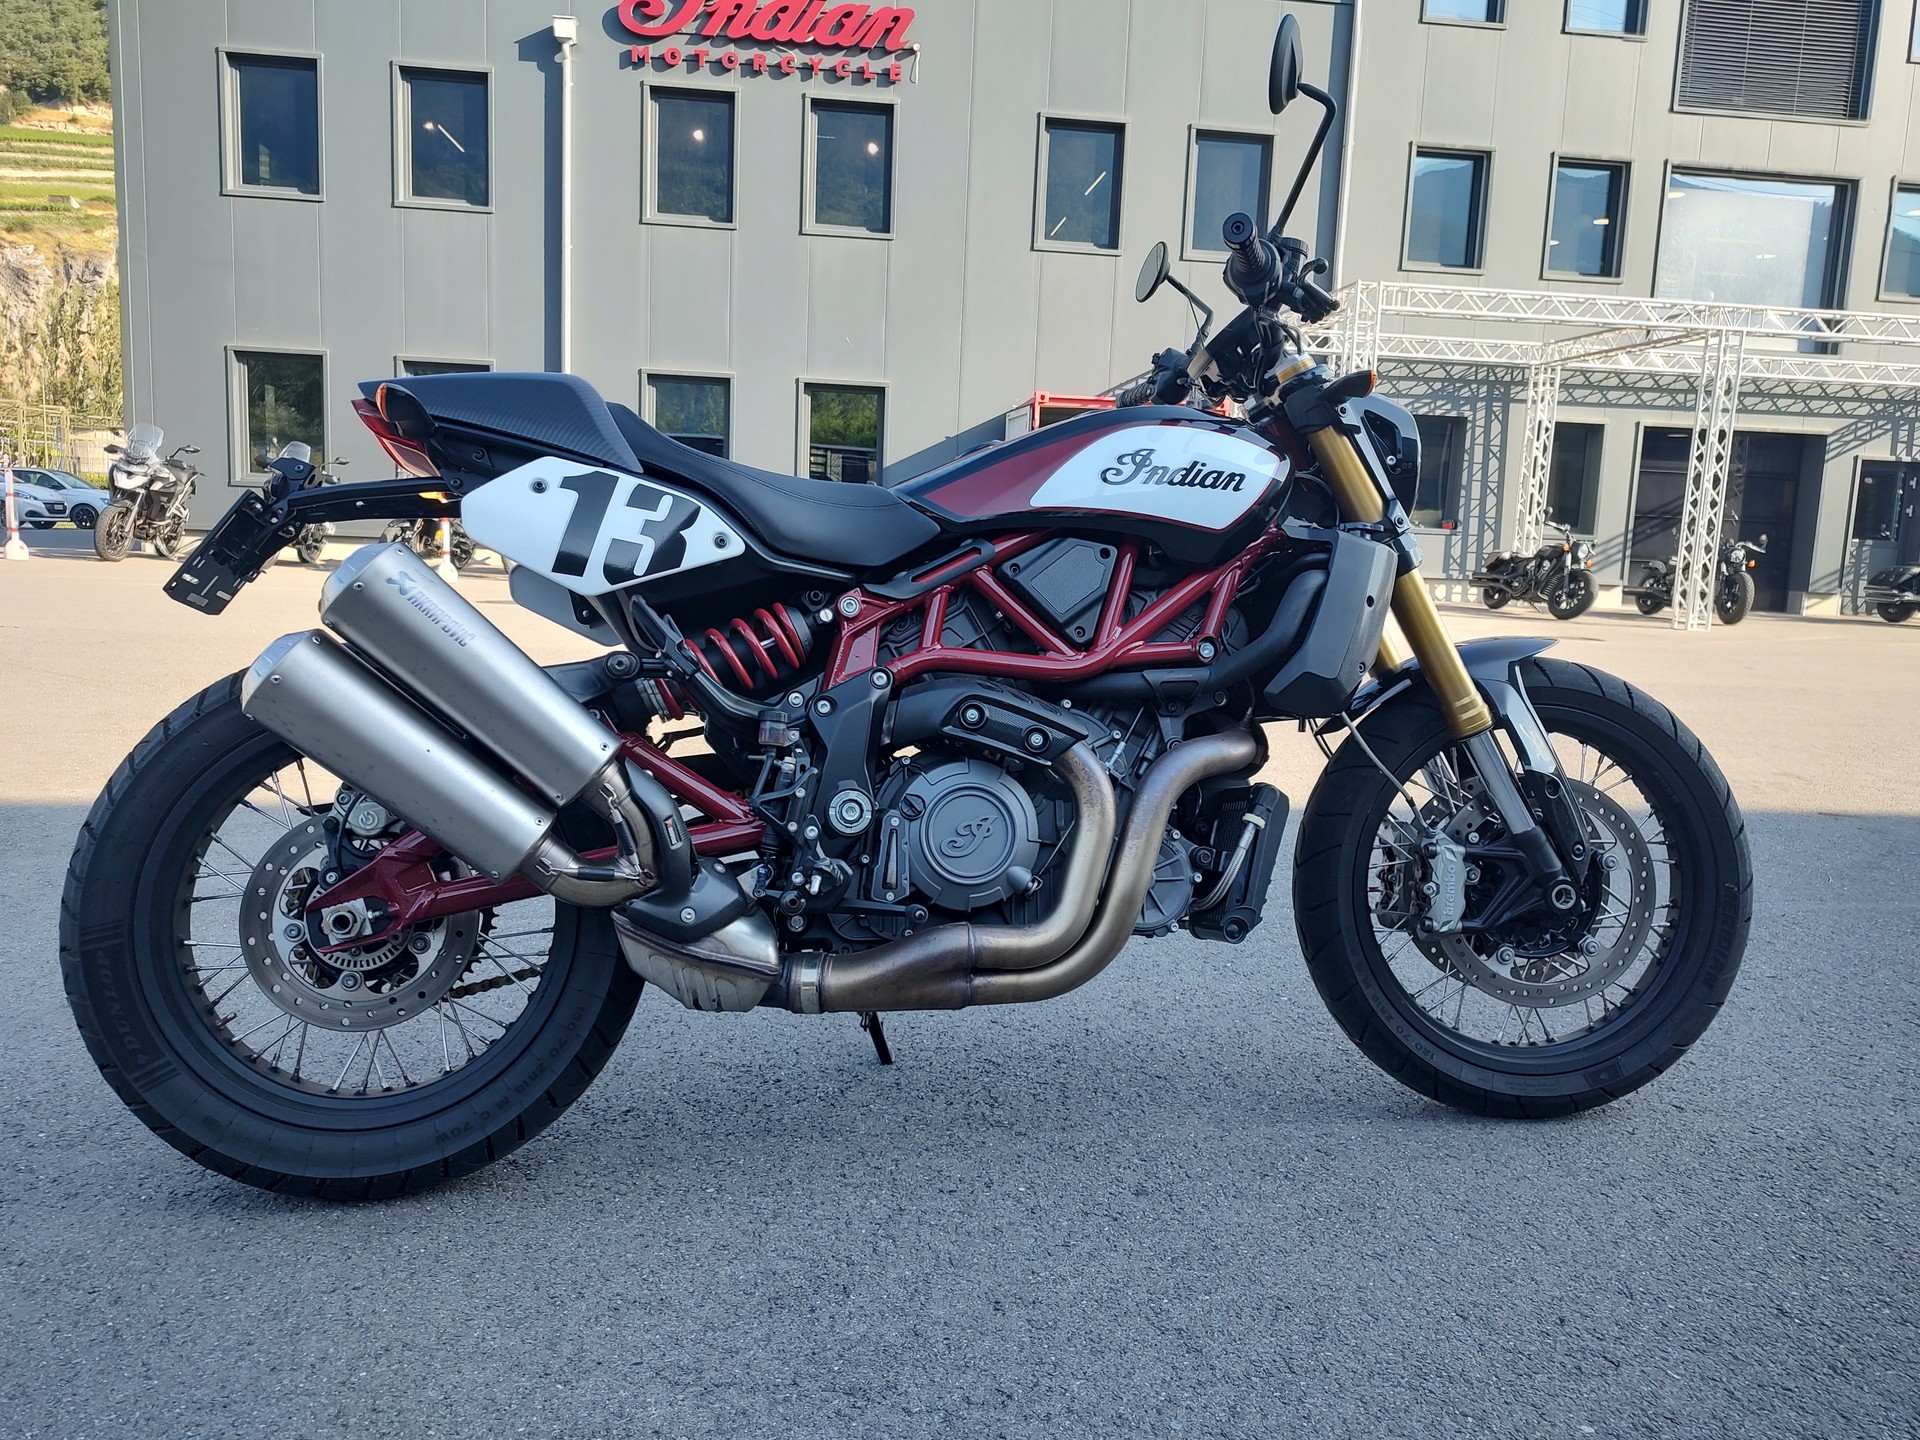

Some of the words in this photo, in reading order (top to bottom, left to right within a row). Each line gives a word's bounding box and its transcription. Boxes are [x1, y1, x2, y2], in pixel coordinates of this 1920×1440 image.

[618, 0, 915, 51] Indian
[631, 45, 902, 82] MOTORCYCLE
[1100, 448, 1246, 492] Indian
[551, 470, 702, 586] 13
[1442, 864, 1456, 916] brembo
